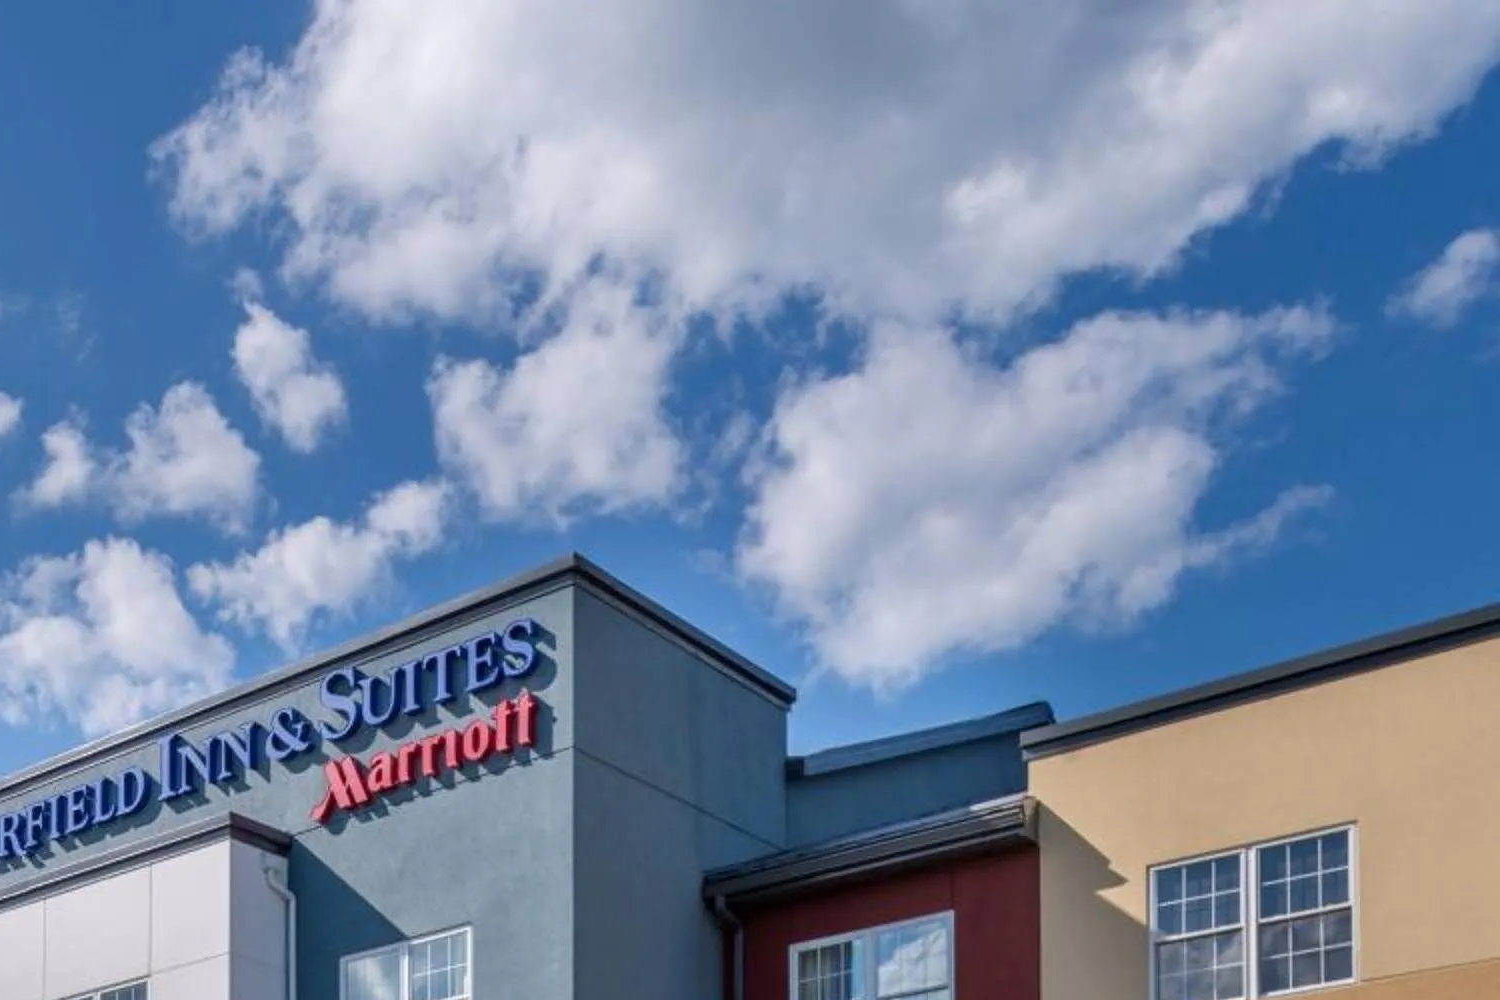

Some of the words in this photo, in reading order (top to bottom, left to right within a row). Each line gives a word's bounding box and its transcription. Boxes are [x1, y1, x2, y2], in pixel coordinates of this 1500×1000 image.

[157, 721, 262, 801] INN
[266, 706, 312, 762] &
[319, 618, 537, 742] SUITES
[309, 687, 539, 825] Marriott
